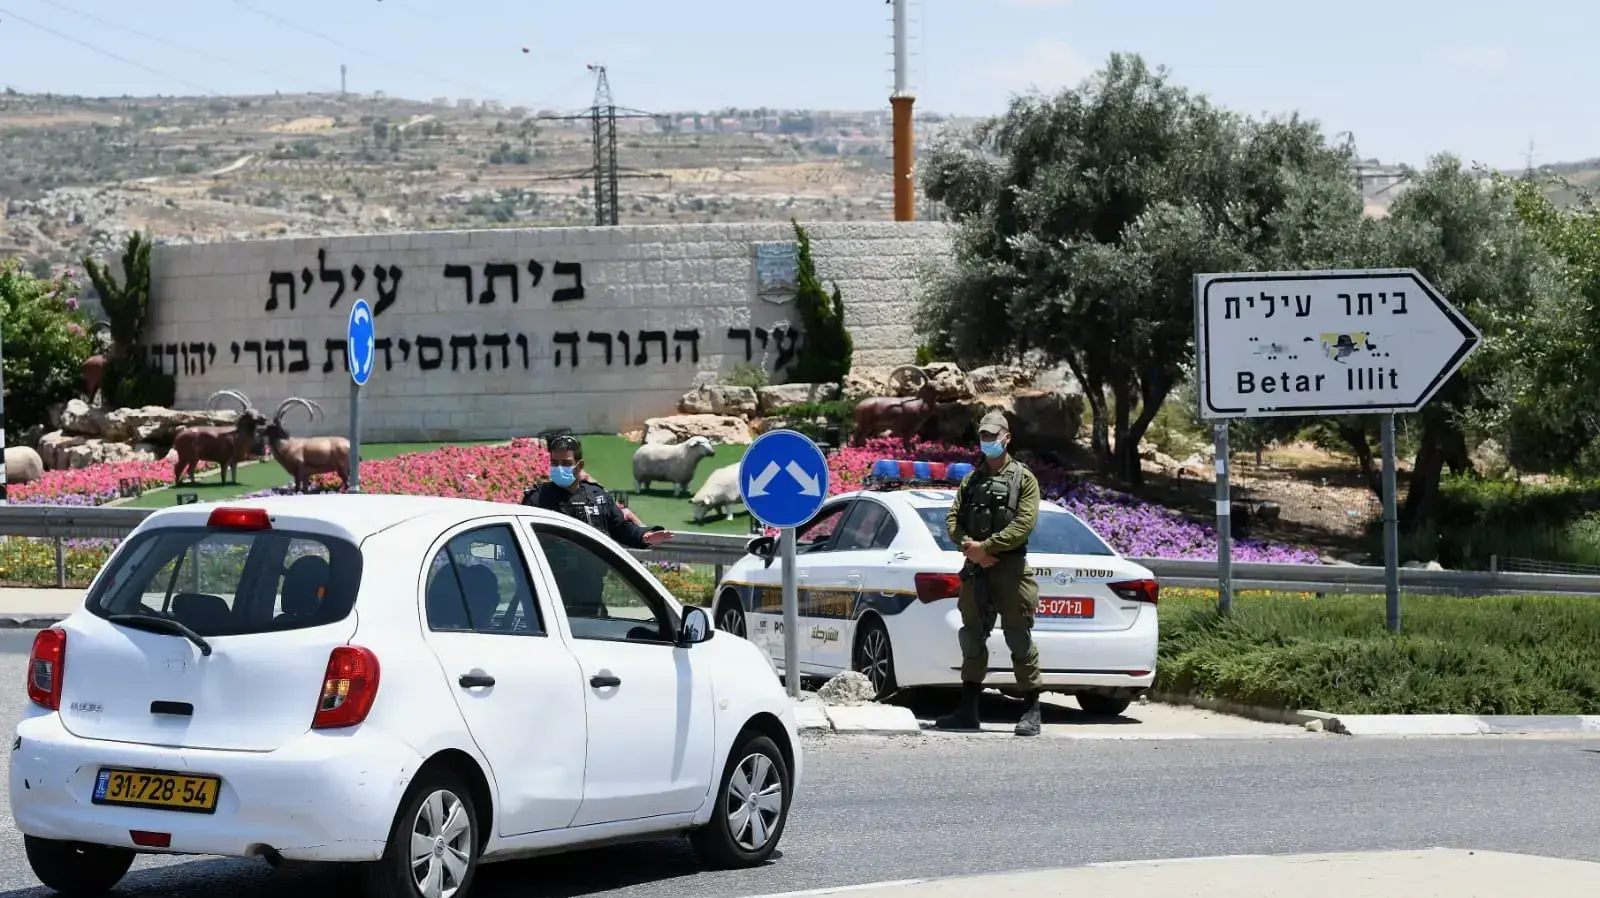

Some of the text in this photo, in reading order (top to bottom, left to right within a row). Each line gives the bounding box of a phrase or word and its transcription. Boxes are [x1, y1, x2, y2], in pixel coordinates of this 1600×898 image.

[265, 247, 585, 317] ביתר עילית
[1224, 291, 1408, 320] ביתר עילית
[230, 338, 310, 374] בהרי
[322, 331, 529, 374] והחסידת
[553, 328, 700, 367] התורה
[727, 326, 800, 372] עיר
[1237, 367, 1399, 395] Betar Illit
[1075, 567, 1114, 578] משטרת
